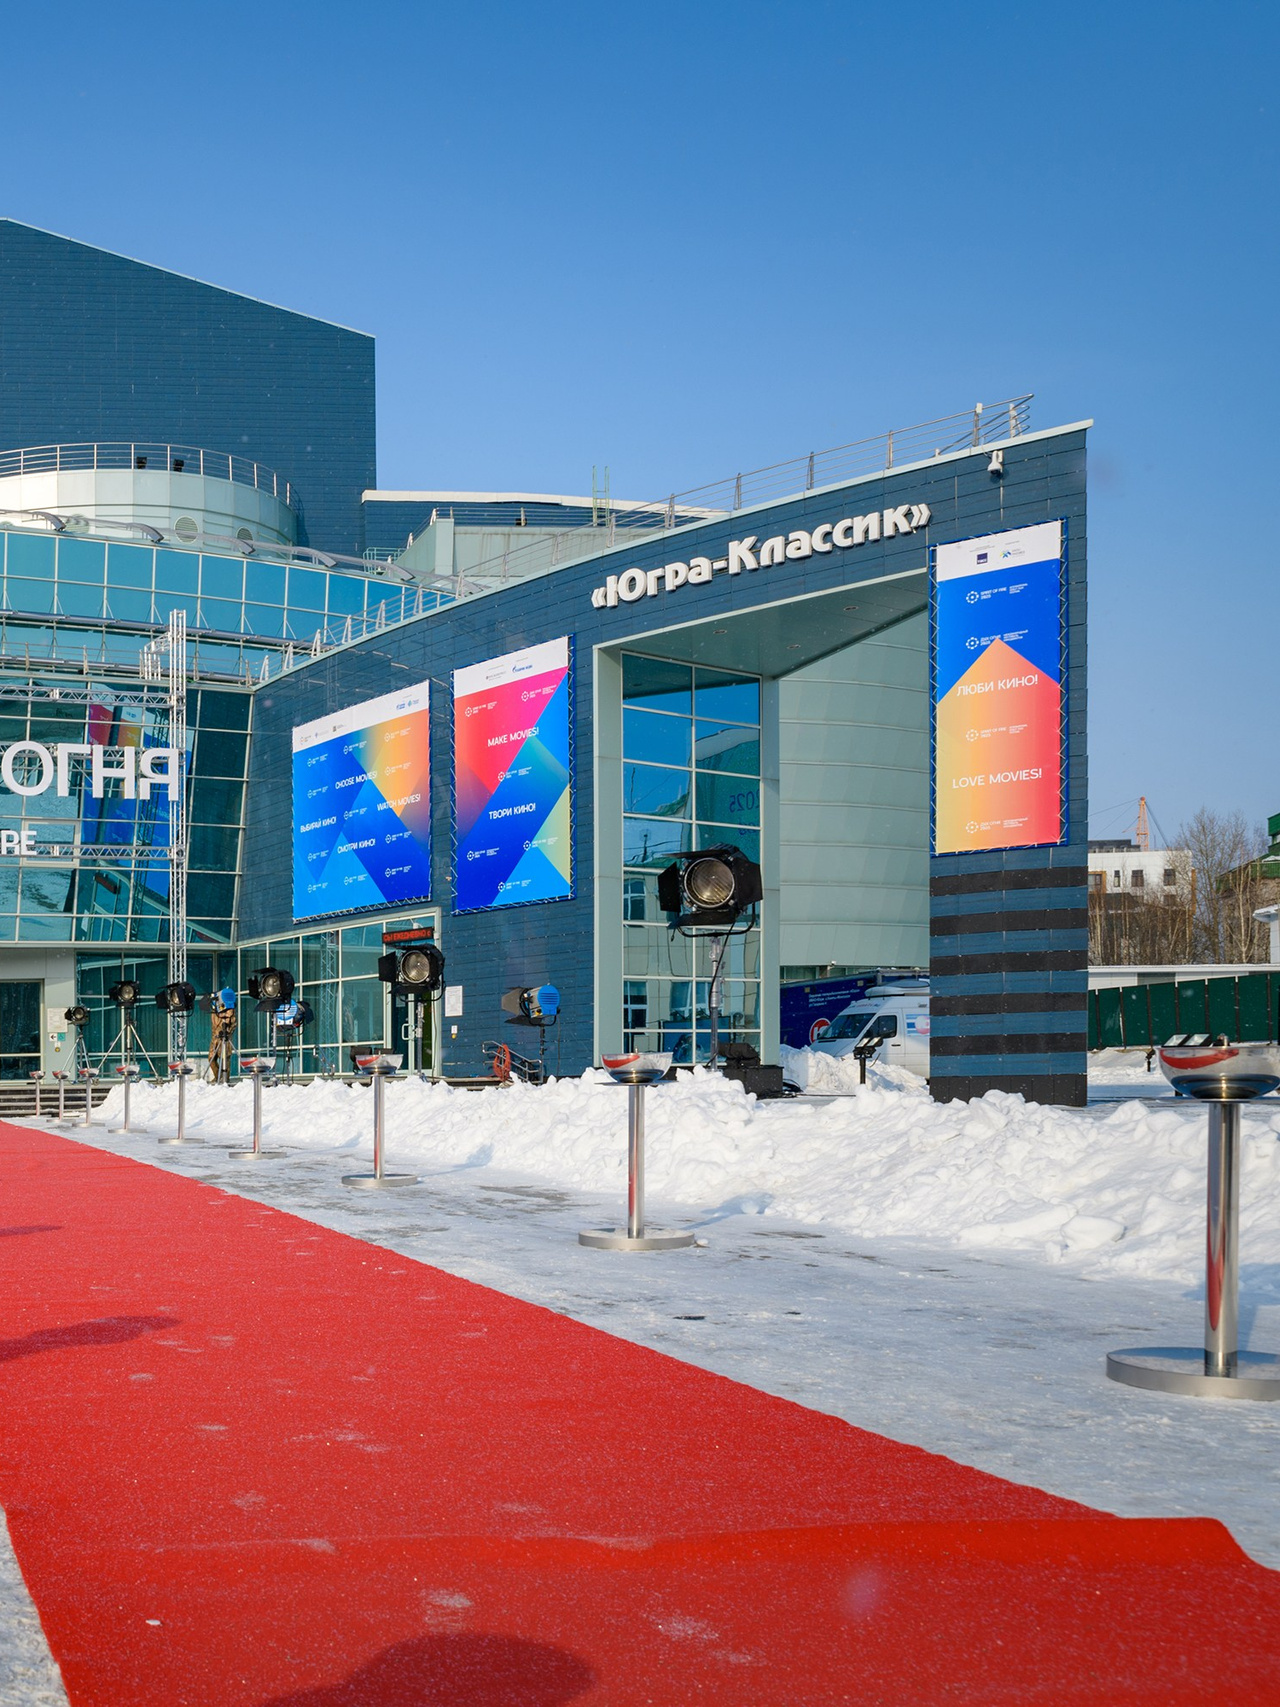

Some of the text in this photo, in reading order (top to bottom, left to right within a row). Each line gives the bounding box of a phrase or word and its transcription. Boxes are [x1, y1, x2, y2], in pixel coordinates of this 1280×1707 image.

[591, 503, 933, 609] «Югра-Классик»
[956, 674, 1038, 697] ЛЮБИ КИНО!
[488, 727, 539, 747] MAKE MOVIES!
[1, 740, 179, 802] ОГНЯ
[952, 768, 1042, 789] LOVE MOVIES!
[335, 776, 354, 789] CHOOSE
[377, 800, 396, 811] WATCH
[489, 803, 536, 820] ТВОРИ КИНО!
